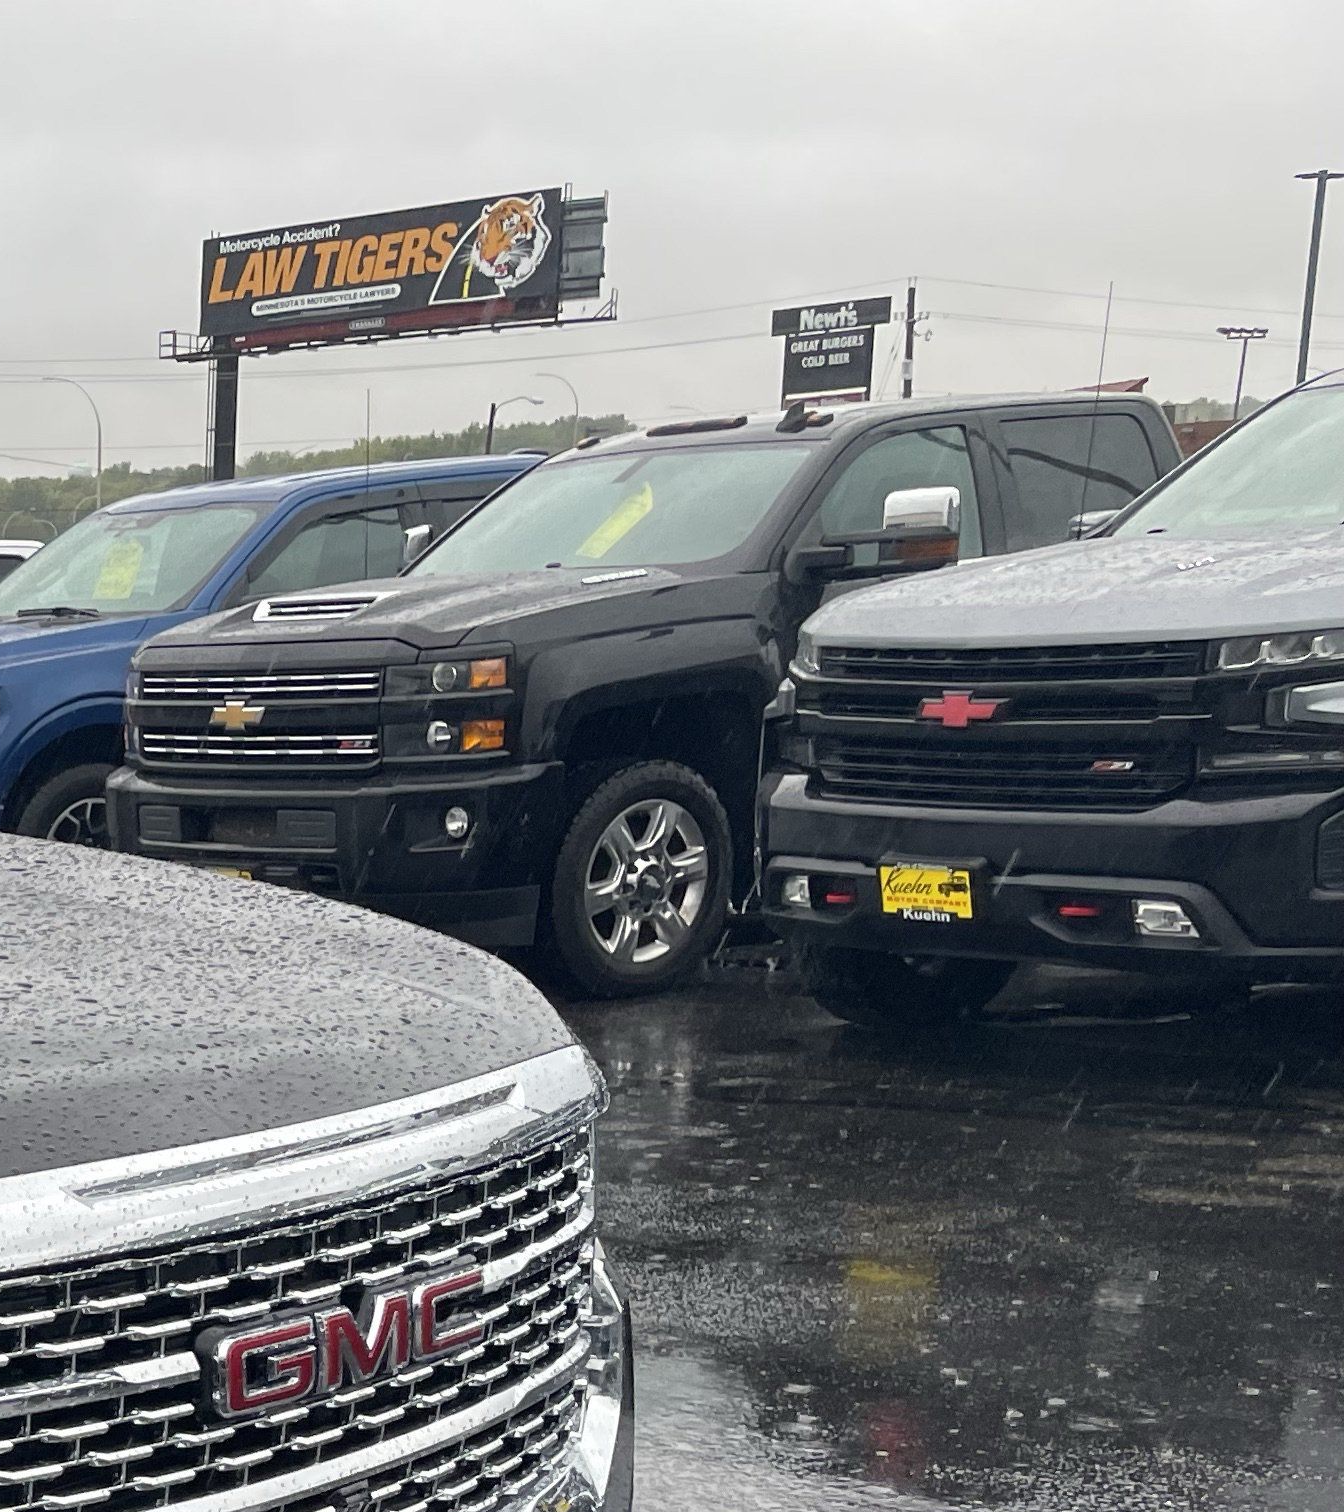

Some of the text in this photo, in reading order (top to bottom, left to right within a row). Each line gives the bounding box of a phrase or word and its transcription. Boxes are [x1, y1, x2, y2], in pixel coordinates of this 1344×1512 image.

[219, 224, 341, 255] Motorcycle Accident?
[208, 222, 459, 304] LAW TIGERS
[306, 292, 358, 308] MOTORCYCLE
[359, 286, 397, 300] LAWYERS
[799, 302, 858, 331] Newt's
[790, 335, 865, 354] GREAT BURGERS
[801, 355, 826, 368] COLD
[883, 869, 932, 896] Kuehn
[903, 908, 951, 922] Kuehn
[214, 1264, 486, 1418] GMC
